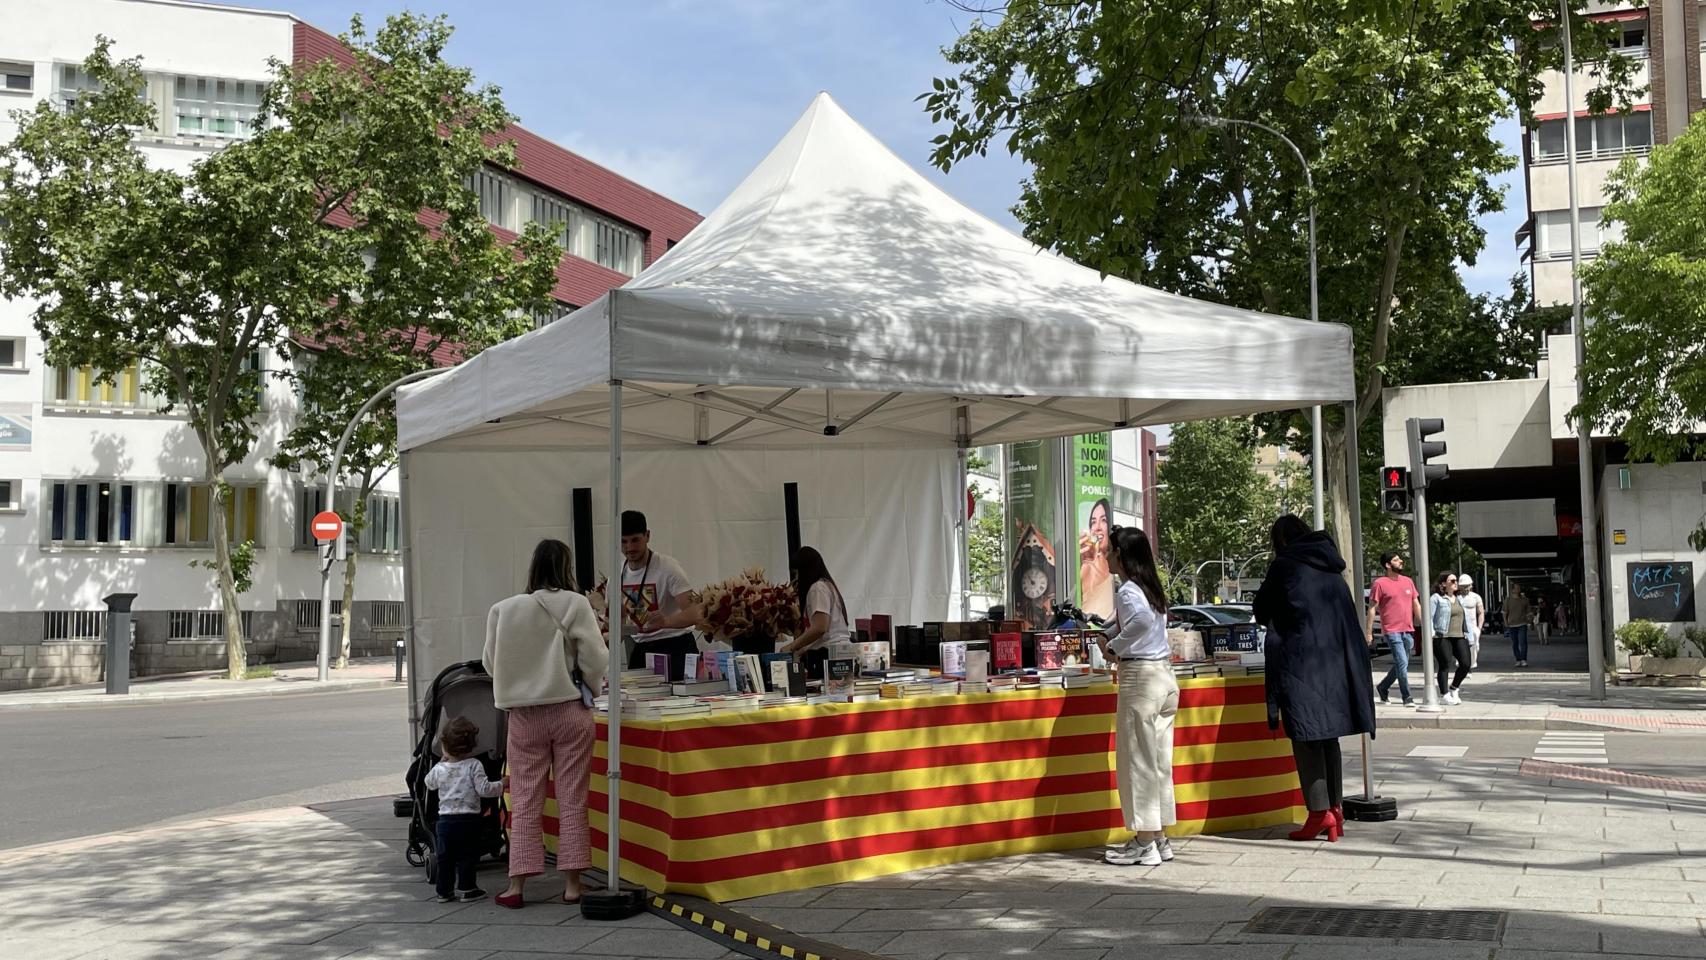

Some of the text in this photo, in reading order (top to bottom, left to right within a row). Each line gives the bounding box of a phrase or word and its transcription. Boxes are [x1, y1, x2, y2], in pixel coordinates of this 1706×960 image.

[1081, 448, 1108, 461] NOM
[1082, 485, 1106, 496] PONLE
[1237, 641, 1253, 649] TRES
